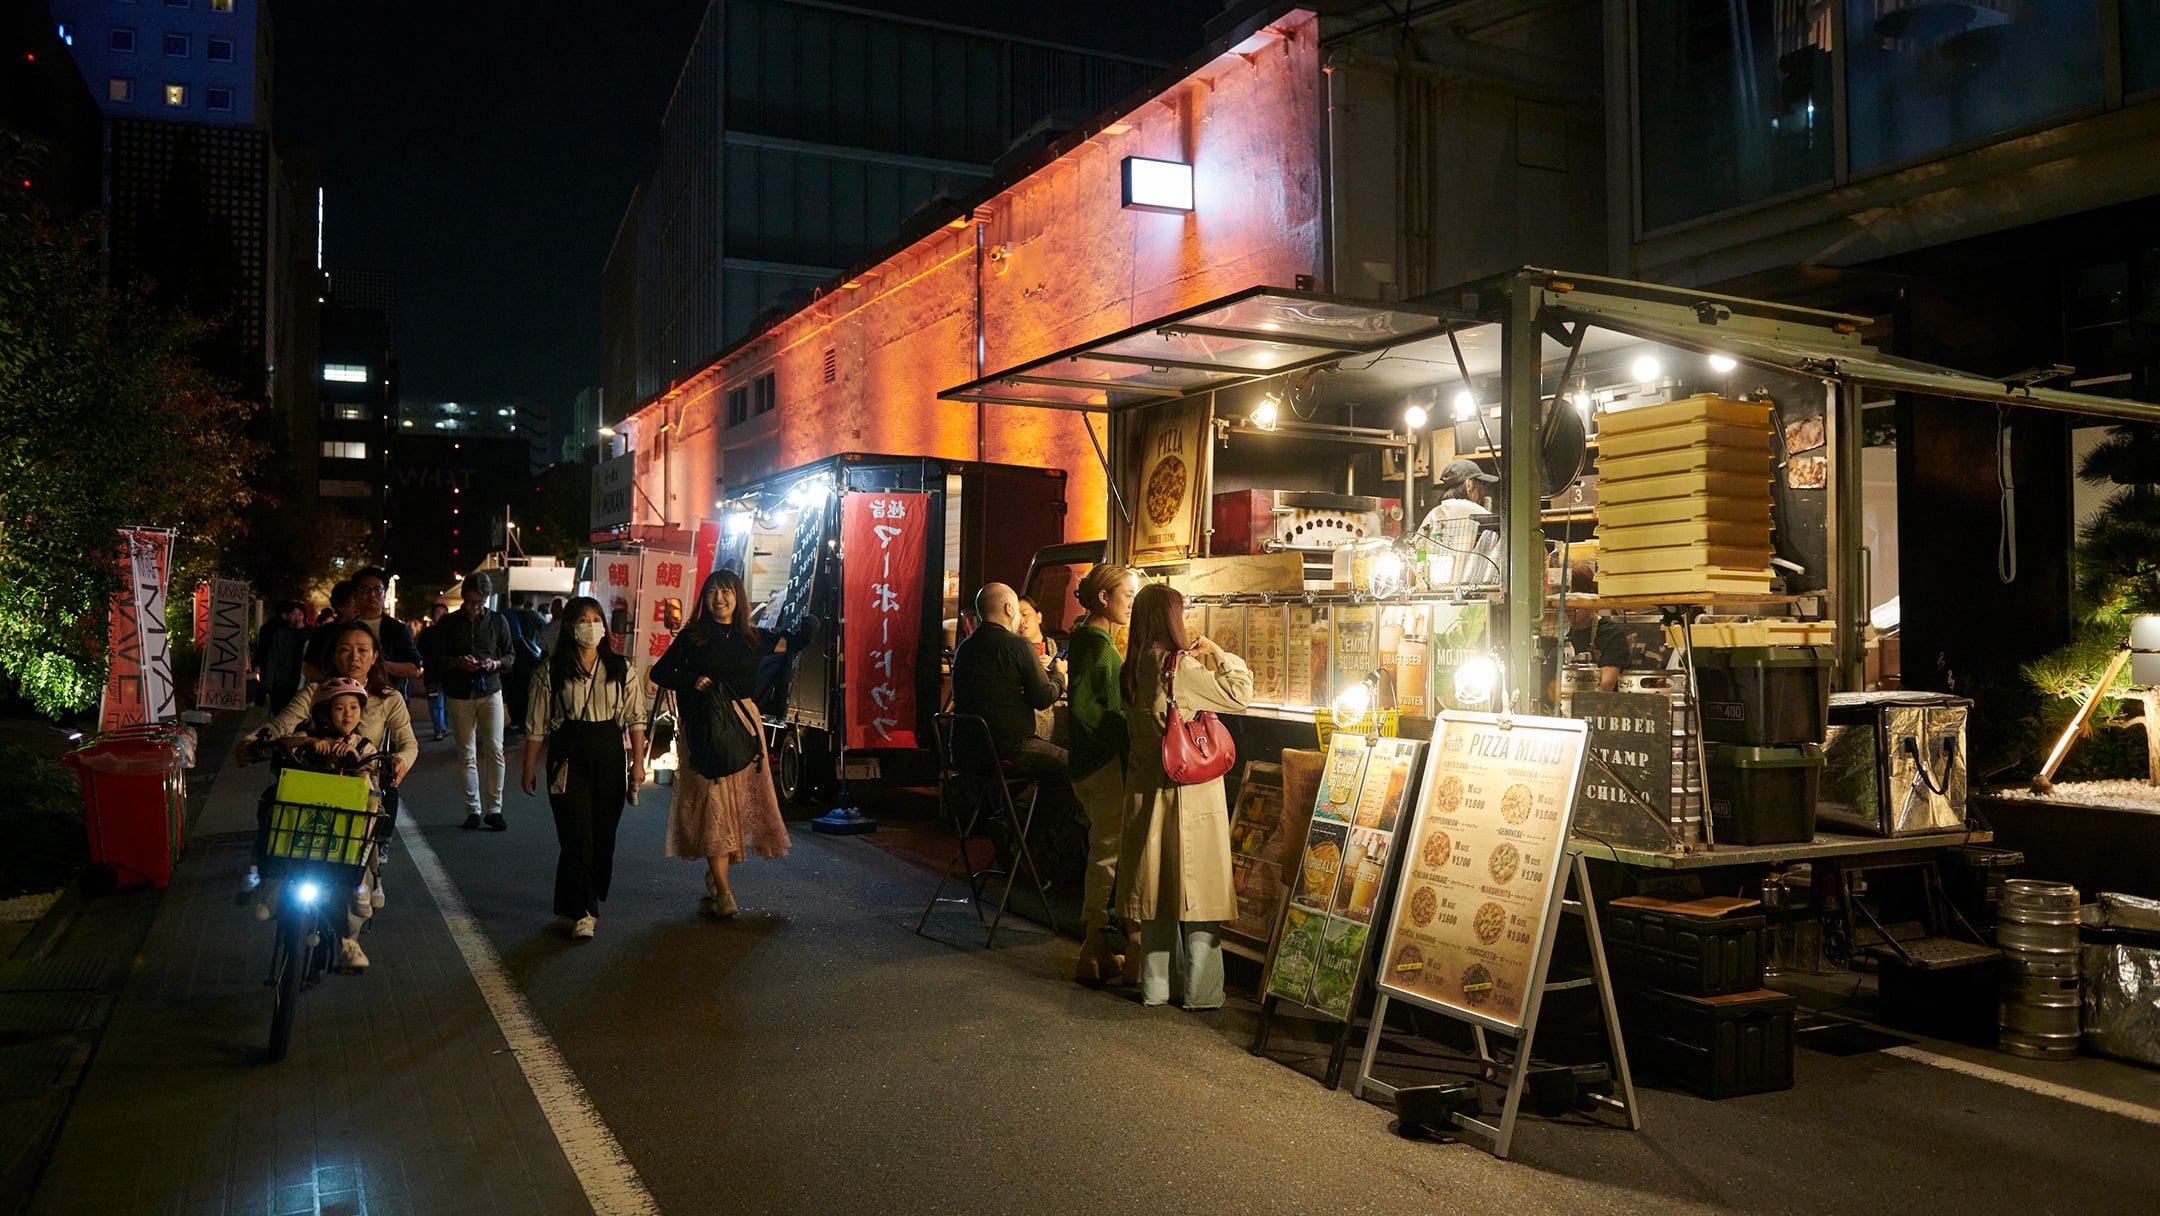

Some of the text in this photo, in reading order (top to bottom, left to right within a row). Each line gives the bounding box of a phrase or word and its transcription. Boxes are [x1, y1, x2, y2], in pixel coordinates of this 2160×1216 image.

[1157, 428, 1183, 460] PIZZA
[1575, 488, 1582, 502] 3
[218, 585, 249, 600] MYAF
[608, 562, 629, 654] 鯛湯
[210, 600, 243, 689] MYAF
[1340, 637, 1369, 653] LEMON
[1338, 655, 1370, 672] SQUASH
[1382, 653, 1422, 666] DRAFT BEER
[1437, 648, 1474, 666] MOJIT
[205, 691, 242, 705] MYAF
[1724, 705, 1742, 718] 400
[1468, 733, 1512, 759] PIZZA
[1514, 737, 1565, 766] MENU
[1332, 760, 1358, 776] LEMON
[1328, 774, 1356, 790] SQUASH
[1586, 784, 1650, 805] CHIEO
[1450, 854, 1471, 868] ¥1700
[1361, 871, 1377, 883] BEER
[1519, 868, 1543, 883] ¥1700
[1322, 952, 1351, 974] MOJITO
